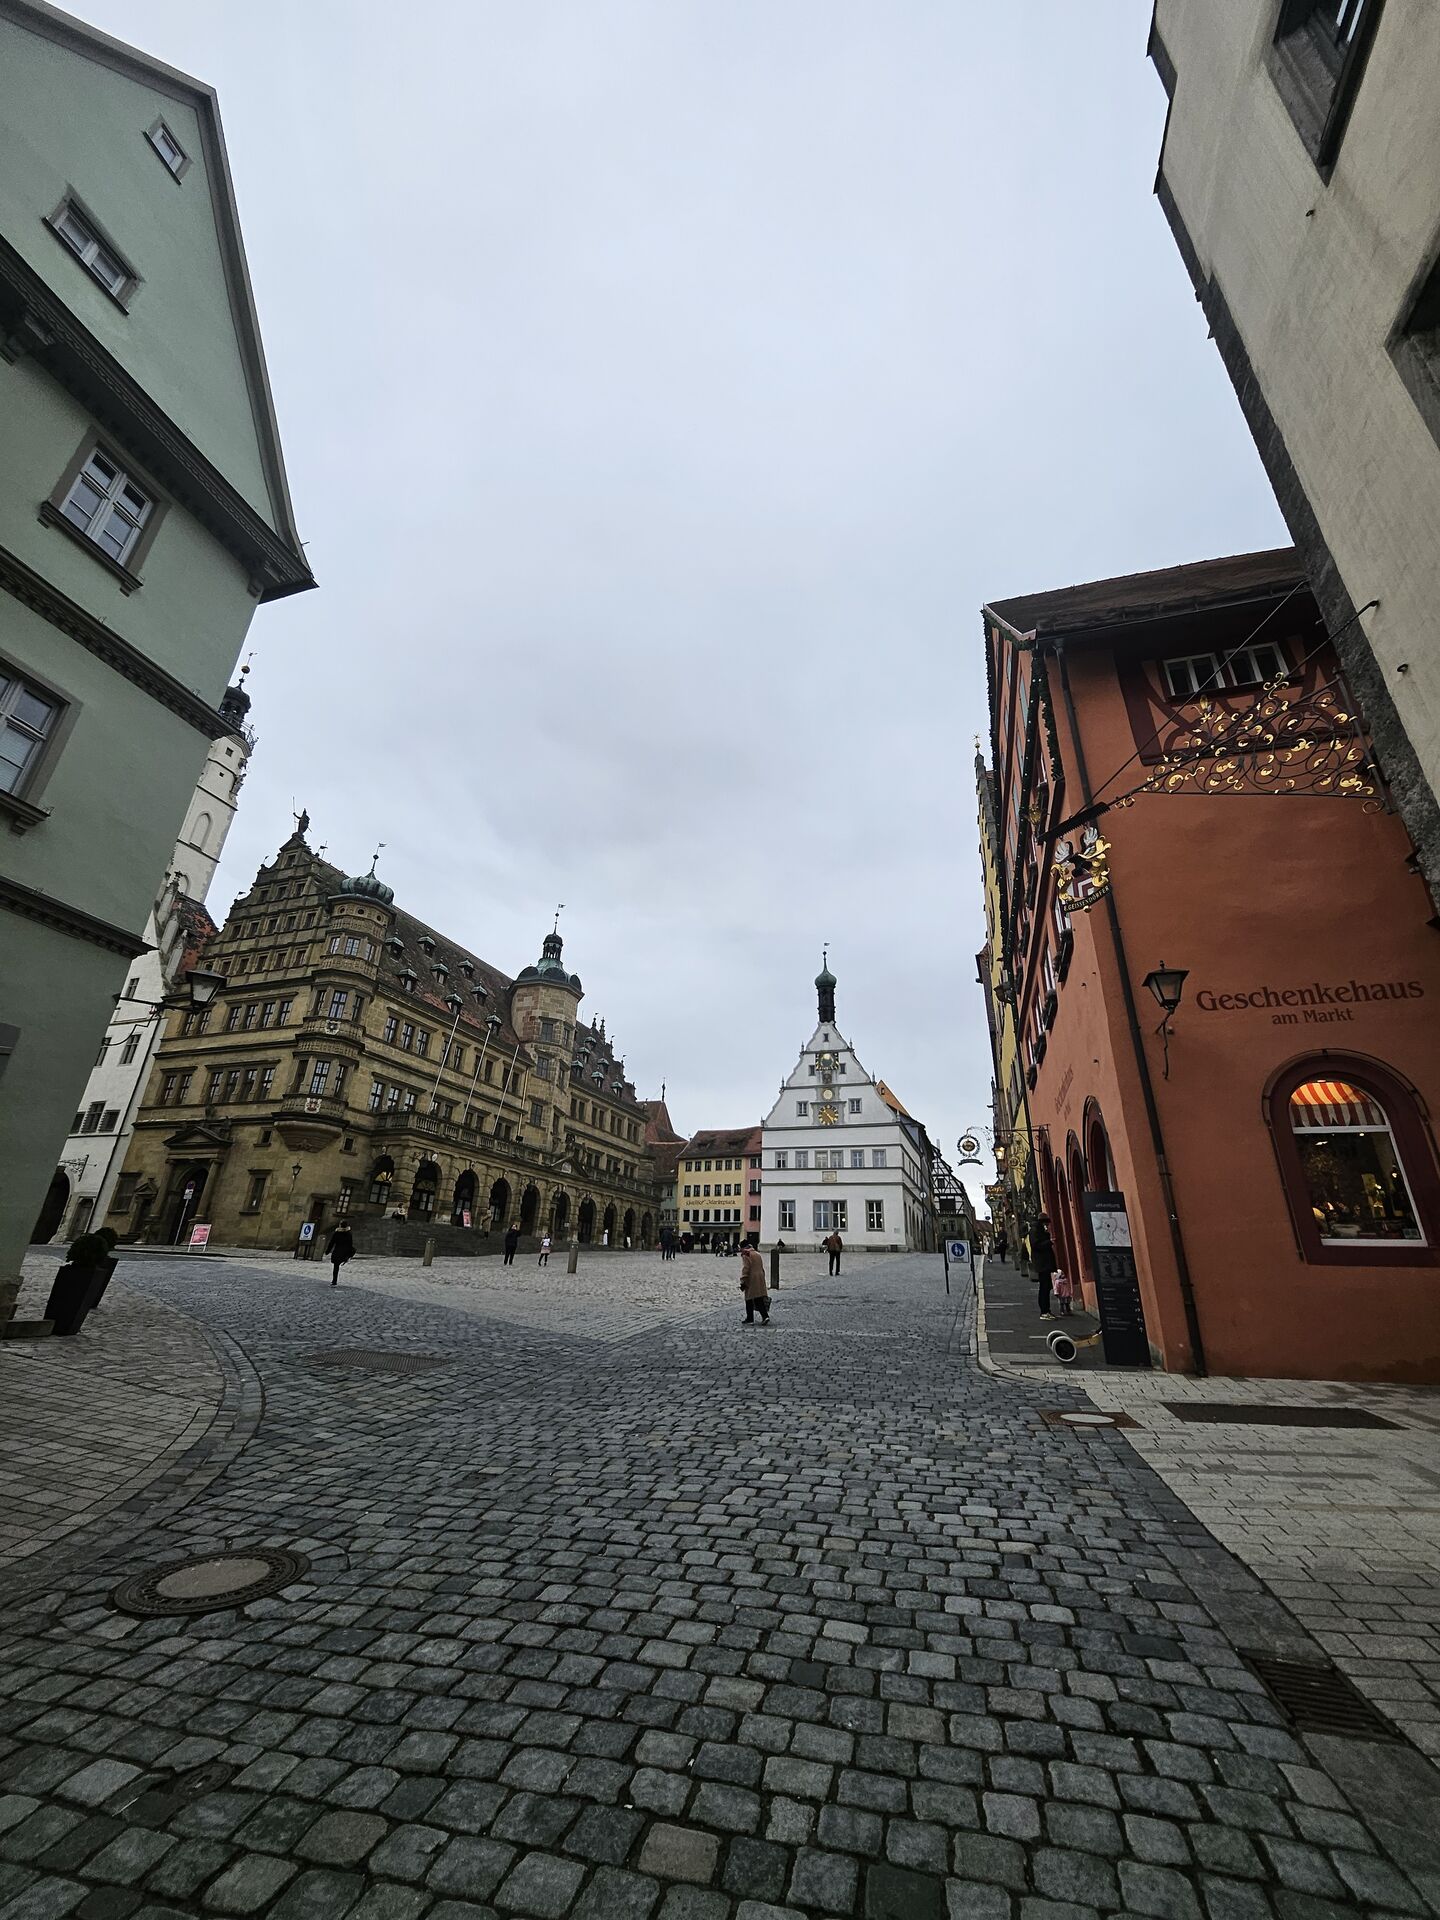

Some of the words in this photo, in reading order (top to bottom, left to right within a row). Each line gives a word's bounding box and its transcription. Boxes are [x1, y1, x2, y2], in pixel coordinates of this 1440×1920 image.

[1196, 980, 1424, 1011] Geschenkehaus
[1272, 1013, 1299, 1025] am
[1303, 1008, 1355, 1024] Markt
